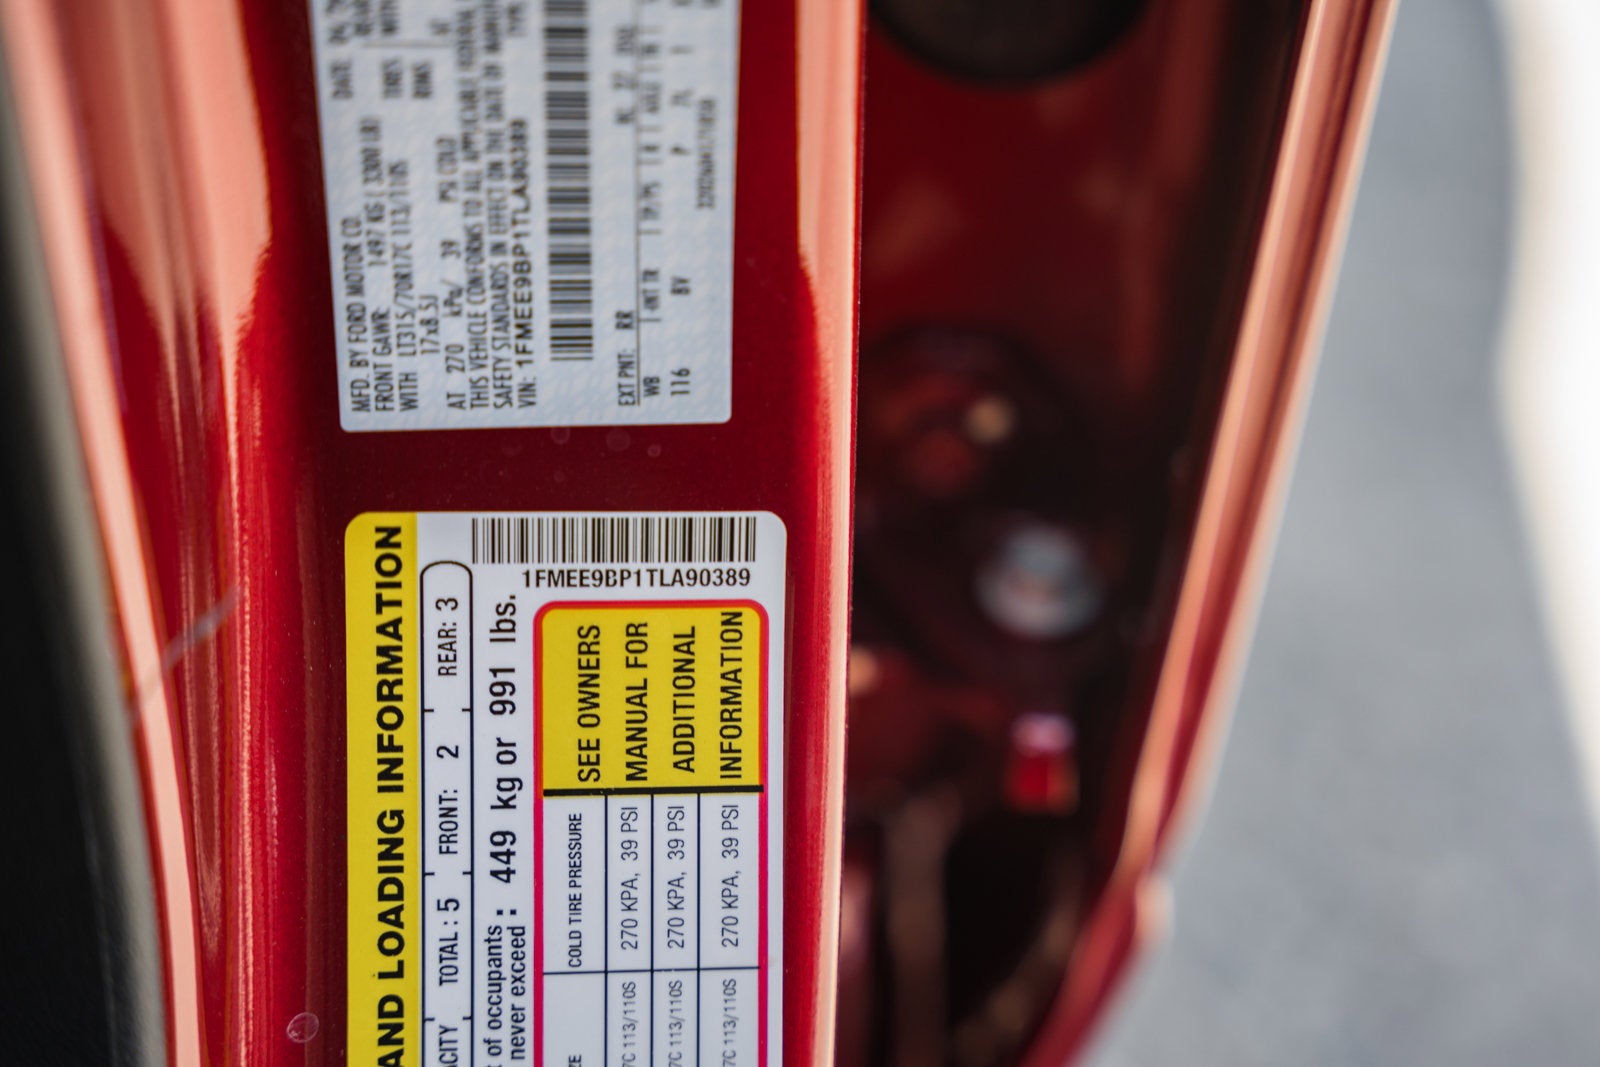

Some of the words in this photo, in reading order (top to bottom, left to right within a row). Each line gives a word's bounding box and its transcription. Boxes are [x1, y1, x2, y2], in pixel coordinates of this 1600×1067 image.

[367, 229, 387, 266] 1497
[440, 240, 461, 258] 39
[464, 224, 486, 305] CONFORMS
[490, 241, 508, 256] IN
[343, 244, 364, 296] MOTOR
[346, 303, 367, 343] FORD
[490, 262, 512, 350] STANDARDS
[615, 311, 634, 330] RR
[349, 350, 368, 367] BY
[445, 344, 465, 373] 270
[468, 312, 488, 370] VEHICLE
[373, 362, 394, 412] FRONT
[398, 372, 418, 411] WITH
[469, 377, 489, 409] THIS
[492, 356, 513, 409] SAFETY
[517, 377, 536, 408] VIN:
[618, 383, 635, 406] EXT
[642, 376, 660, 396] WB
[671, 368, 690, 396] 116
[447, 392, 466, 410] AT
[522, 569, 750, 588] 1FMEE9BP1TLA90389
[435, 598, 458, 611] 3
[490, 594, 516, 643] lbs.
[374, 526, 404, 794] INFORMATION
[437, 622, 458, 676] REAR:
[626, 622, 648, 668] FOR
[488, 666, 516, 716] 991
[577, 625, 600, 728] OWNERS
[720, 611, 742, 779] INFORMATION
[672, 626, 696, 773] ADDITIONAL
[626, 678, 648, 782] MANUAL
[436, 745, 459, 759] 2
[496, 737, 516, 765] or
[578, 738, 600, 782] SEE
[490, 776, 522, 810] kg
[438, 789, 458, 855] FRONT:
[620, 806, 638, 832] PSI
[667, 806, 684, 832] PSI
[721, 804, 739, 830] PSI
[490, 830, 516, 883] 449
[568, 812, 582, 888] PRESSURE
[620, 840, 638, 862] 39
[667, 838, 684, 860] 39
[721, 838, 739, 859] 39
[376, 809, 405, 980] LOADING
[436, 898, 460, 912] 5
[620, 872, 641, 912] KPA,
[667, 872, 688, 910] KPA,
[721, 870, 742, 909] KPA,
[568, 893, 582, 924] TIRE
[568, 930, 582, 967] COLD
[620, 918, 638, 950] 270
[667, 917, 684, 949] 270
[721, 916, 739, 948] 270
[483, 925, 509, 1030] occupants
[506, 926, 526, 996] exceed
[377, 994, 404, 1067] AND
[483, 1038, 502, 1056] of
[508, 1004, 526, 1060] never
